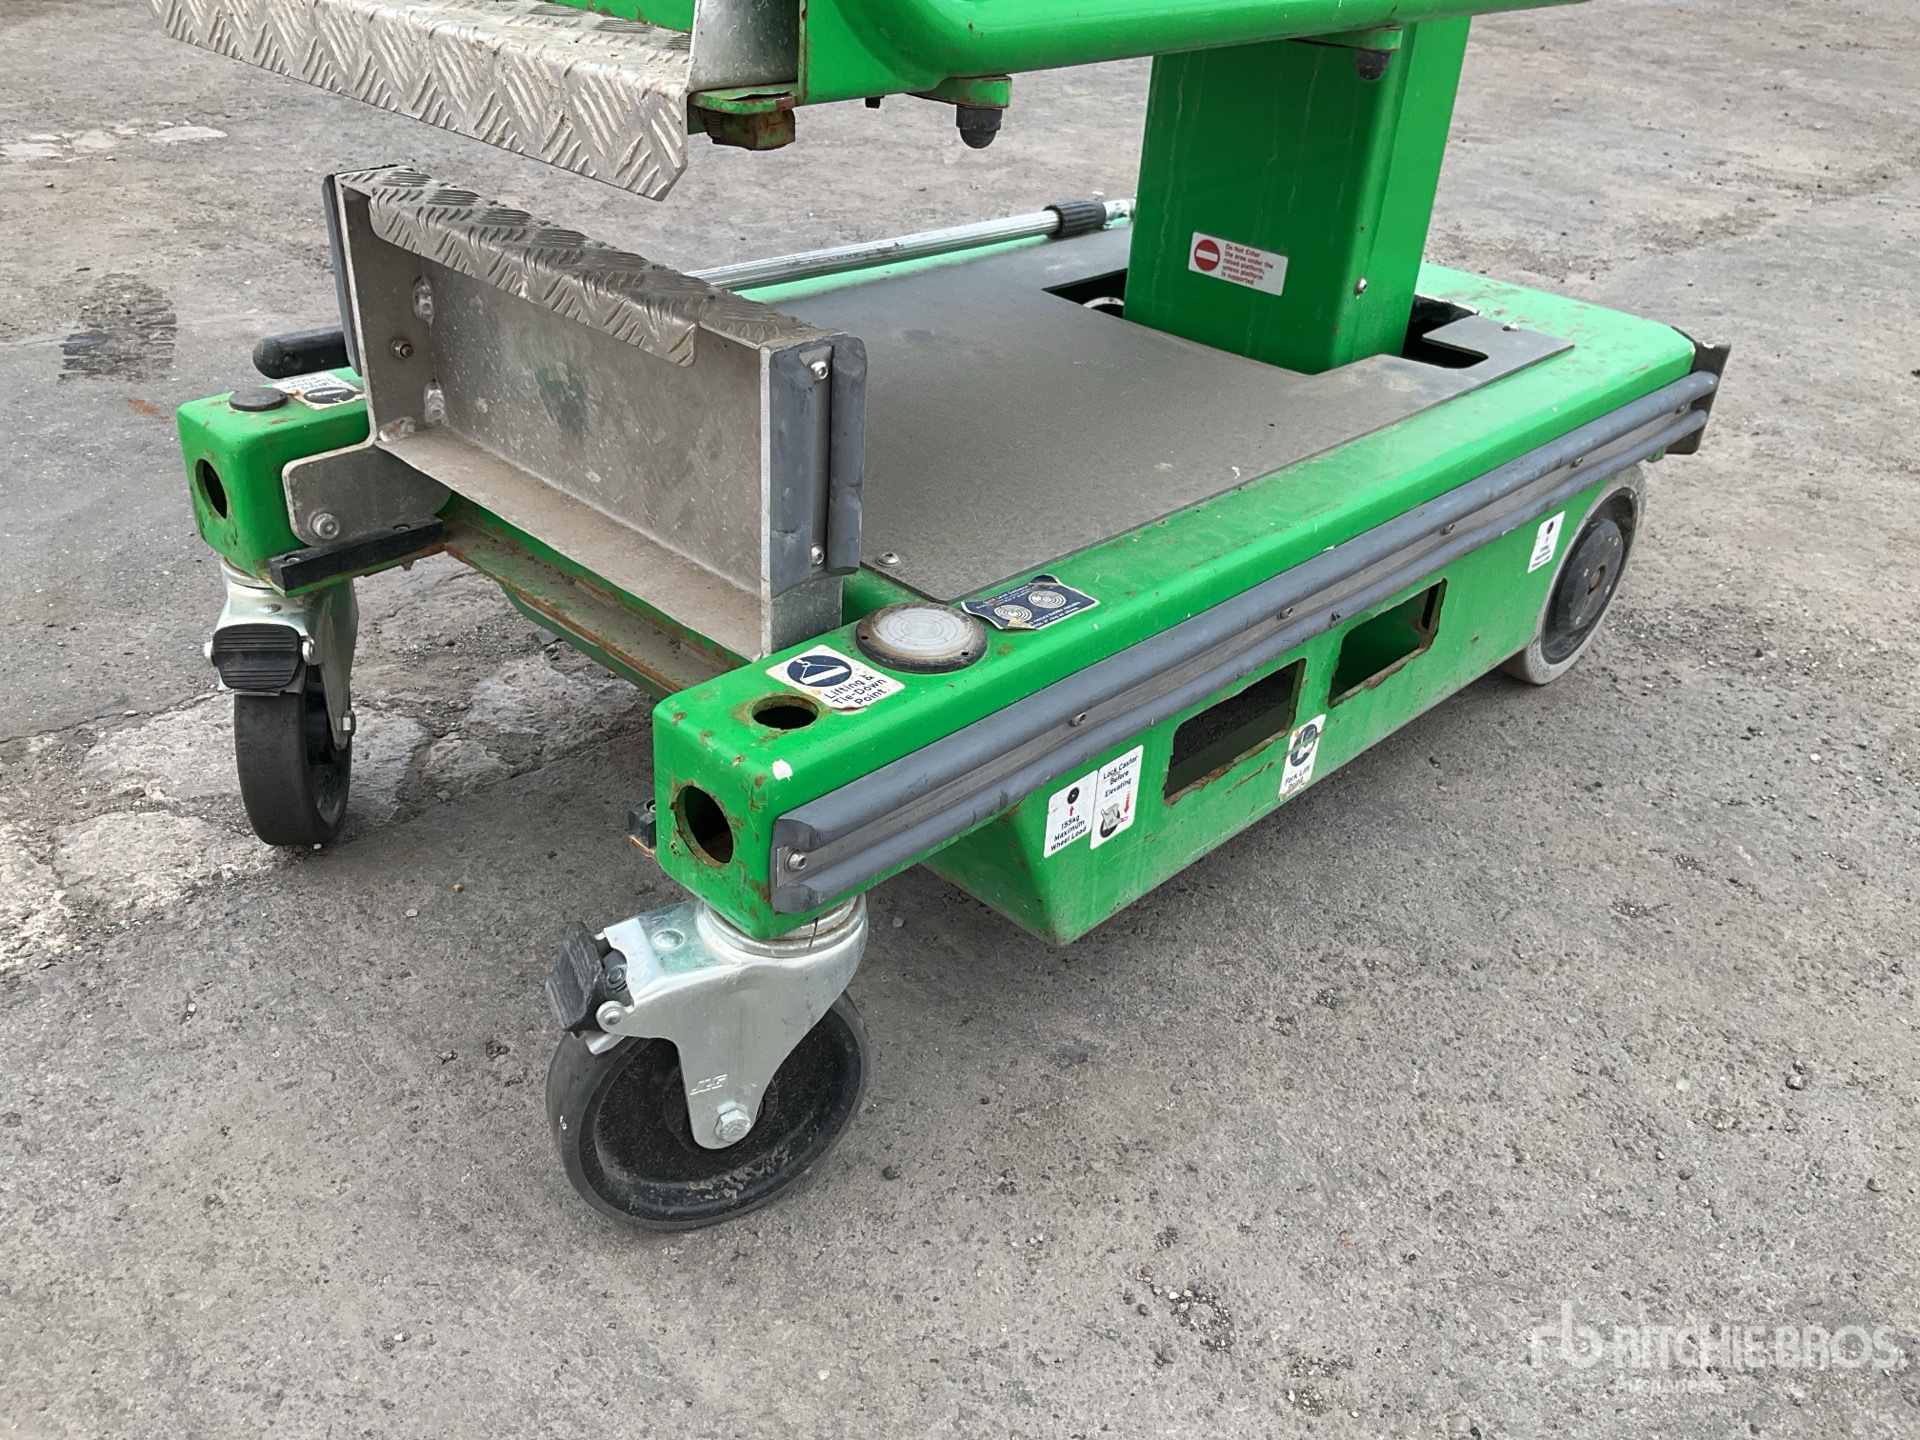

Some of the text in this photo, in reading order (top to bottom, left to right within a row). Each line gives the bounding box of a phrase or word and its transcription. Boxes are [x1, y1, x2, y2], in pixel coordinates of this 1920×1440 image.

[1224, 250, 1274, 269] the area under the
[1225, 243, 1261, 258] Do Not Enter
[1223, 258, 1240, 268] raised
[1222, 264, 1264, 281] unless platform
[1227, 272, 1255, 286] supported
[824, 674, 876, 700] Lifting &
[832, 678, 888, 705] Tie-Down
[854, 689, 888, 706] Point
[1103, 755, 1139, 780] Lock Castor
[1109, 770, 1130, 786] Before
[1104, 778, 1132, 798] Elevating
[1053, 820, 1086, 842] Maximum
[1061, 814, 1081, 831] 155kg
[1050, 826, 1088, 852] Wheel Load
